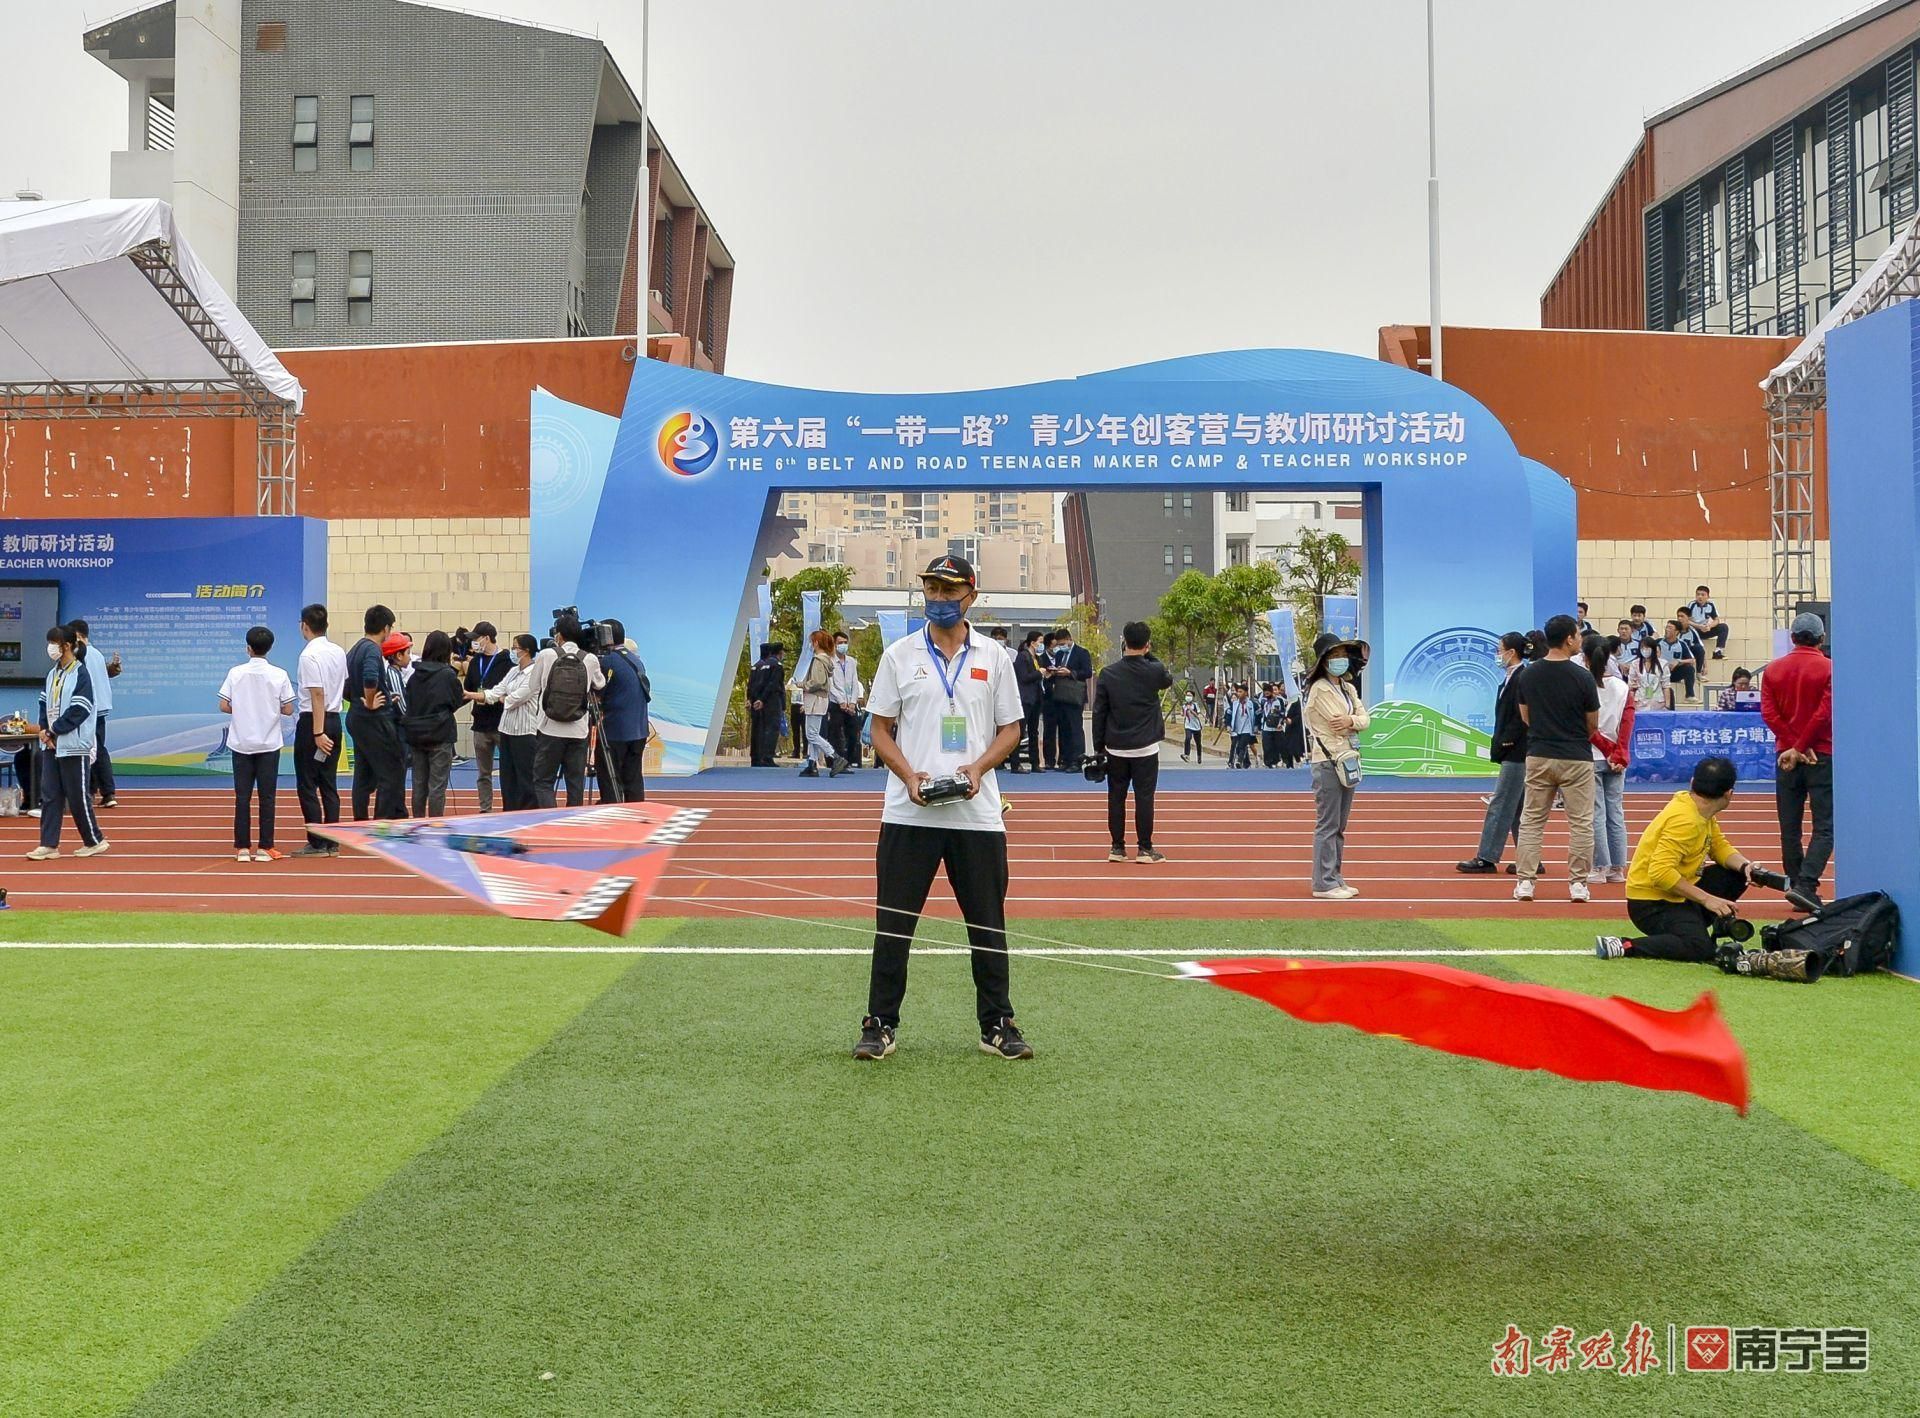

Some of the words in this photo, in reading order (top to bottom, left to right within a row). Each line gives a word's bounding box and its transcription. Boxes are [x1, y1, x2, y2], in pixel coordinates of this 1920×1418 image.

[729, 416, 827, 449] 第六届
[847, 414, 1009, 448] “一带一路”
[1029, 412, 1466, 446] 青少年创客营与教师研讨活动
[727, 457, 763, 471] THE
[775, 457, 797, 471] 6th
[807, 457, 855, 471] BELT
[868, 456, 905, 470] AND
[916, 456, 969, 470] ROAD
[981, 455, 1081, 469] TEENAGER
[1093, 454, 1159, 468] MAKER
[1171, 454, 1224, 468] CAMP
[1236, 455, 1249, 470] &
[1261, 453, 1351, 467] TEACHER
[1363, 452, 1468, 466] WORKSHOP
[0, 533, 114, 553] 教师研讨活动
[46, 557, 114, 568] WORKSHOP
[195, 584, 265, 598] 活动简介
[1680, 748, 1706, 756] XINHUA
[1709, 747, 1730, 755] NEWS
